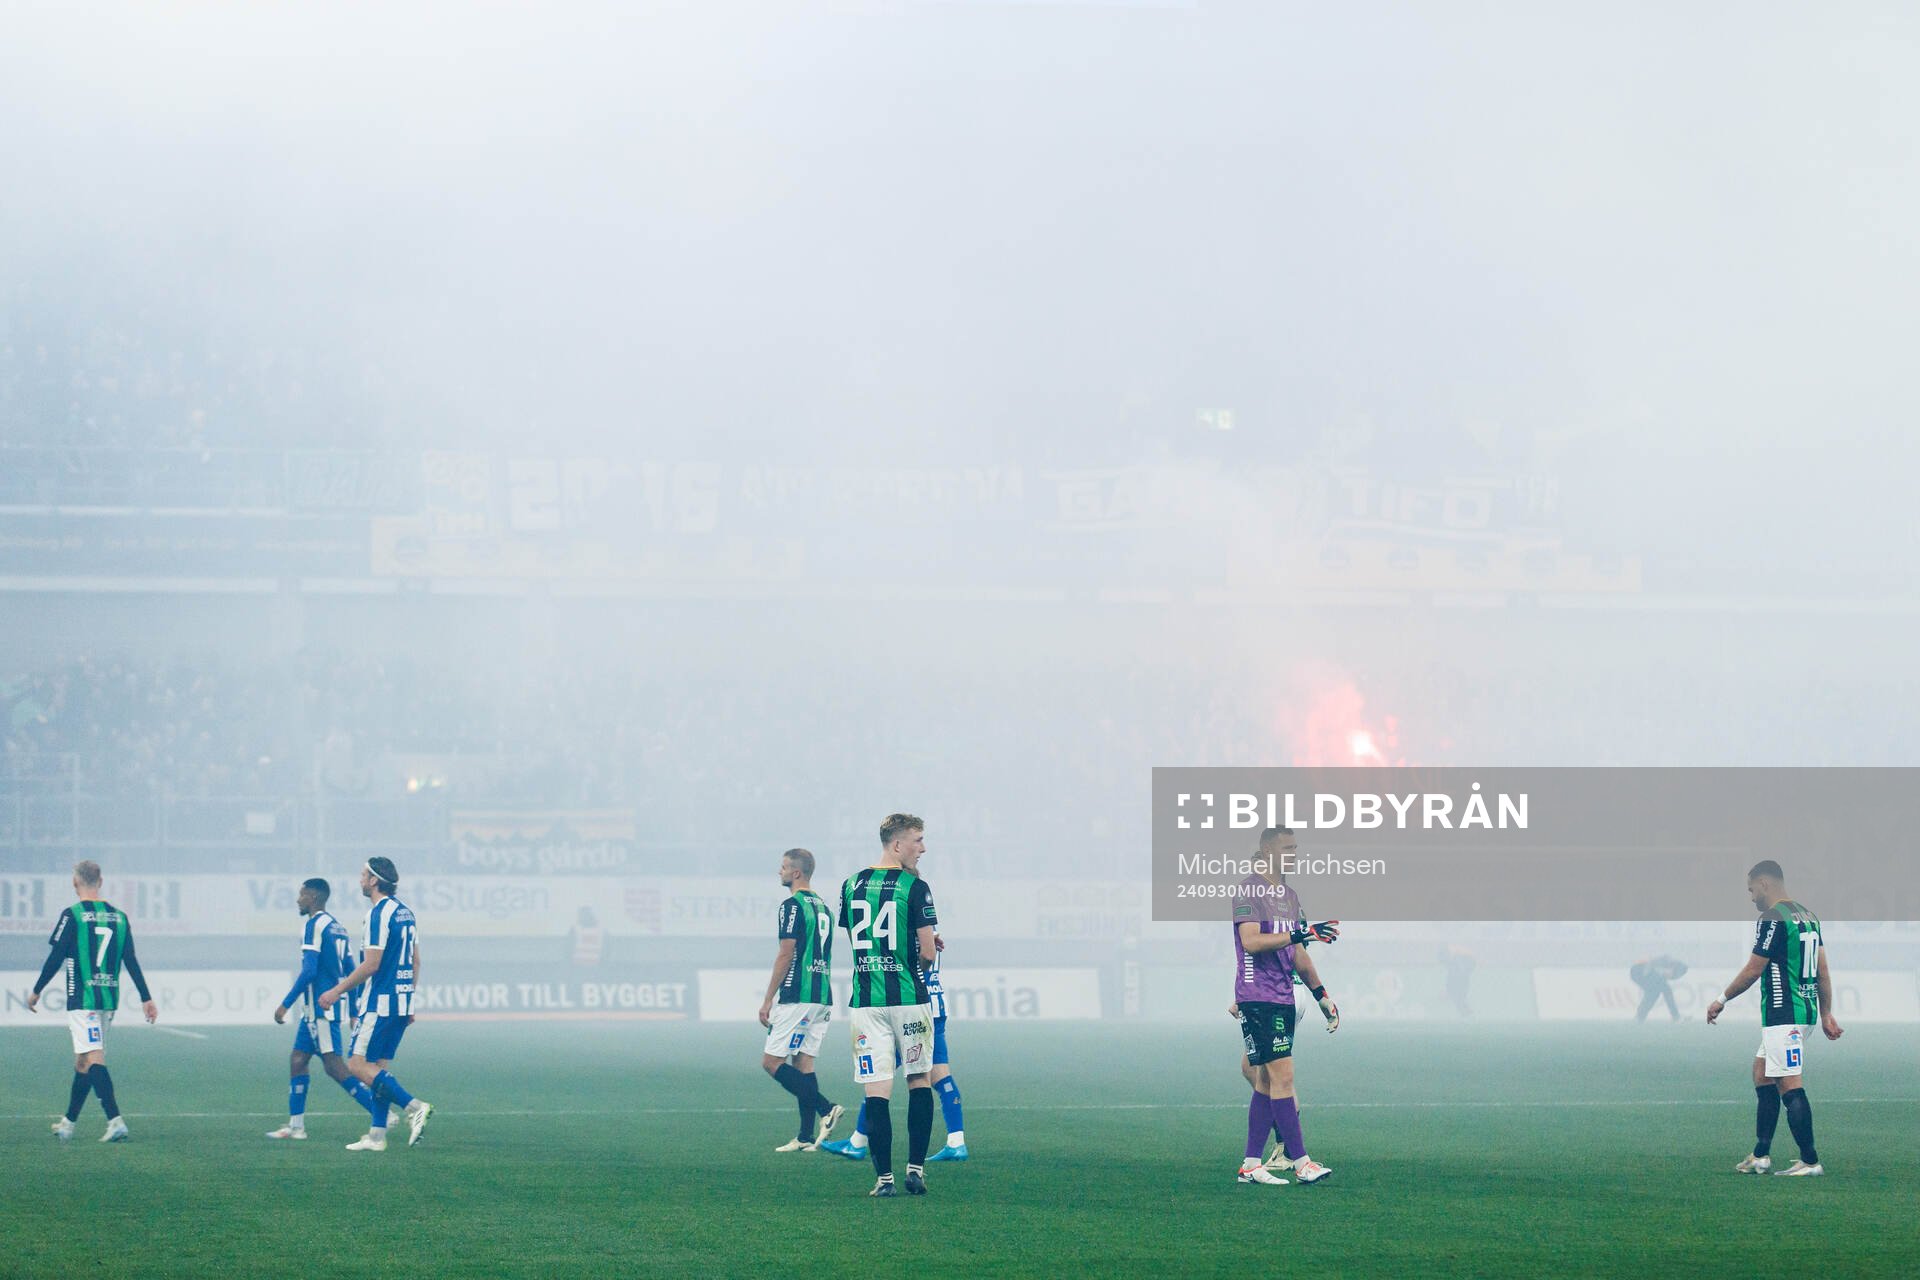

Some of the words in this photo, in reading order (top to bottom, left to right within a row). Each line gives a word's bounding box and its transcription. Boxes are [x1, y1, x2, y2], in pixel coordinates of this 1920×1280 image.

[817, 912, 830, 955] 9
[850, 900, 897, 950] 24
[95, 927, 113, 967] 7
[858, 956, 894, 964] NORDIC
[1799, 931, 1819, 978] 10
[855, 964, 904, 972] WELLNESS
[517, 982, 575, 1009] TILL
[582, 982, 688, 1009] BYGGET
